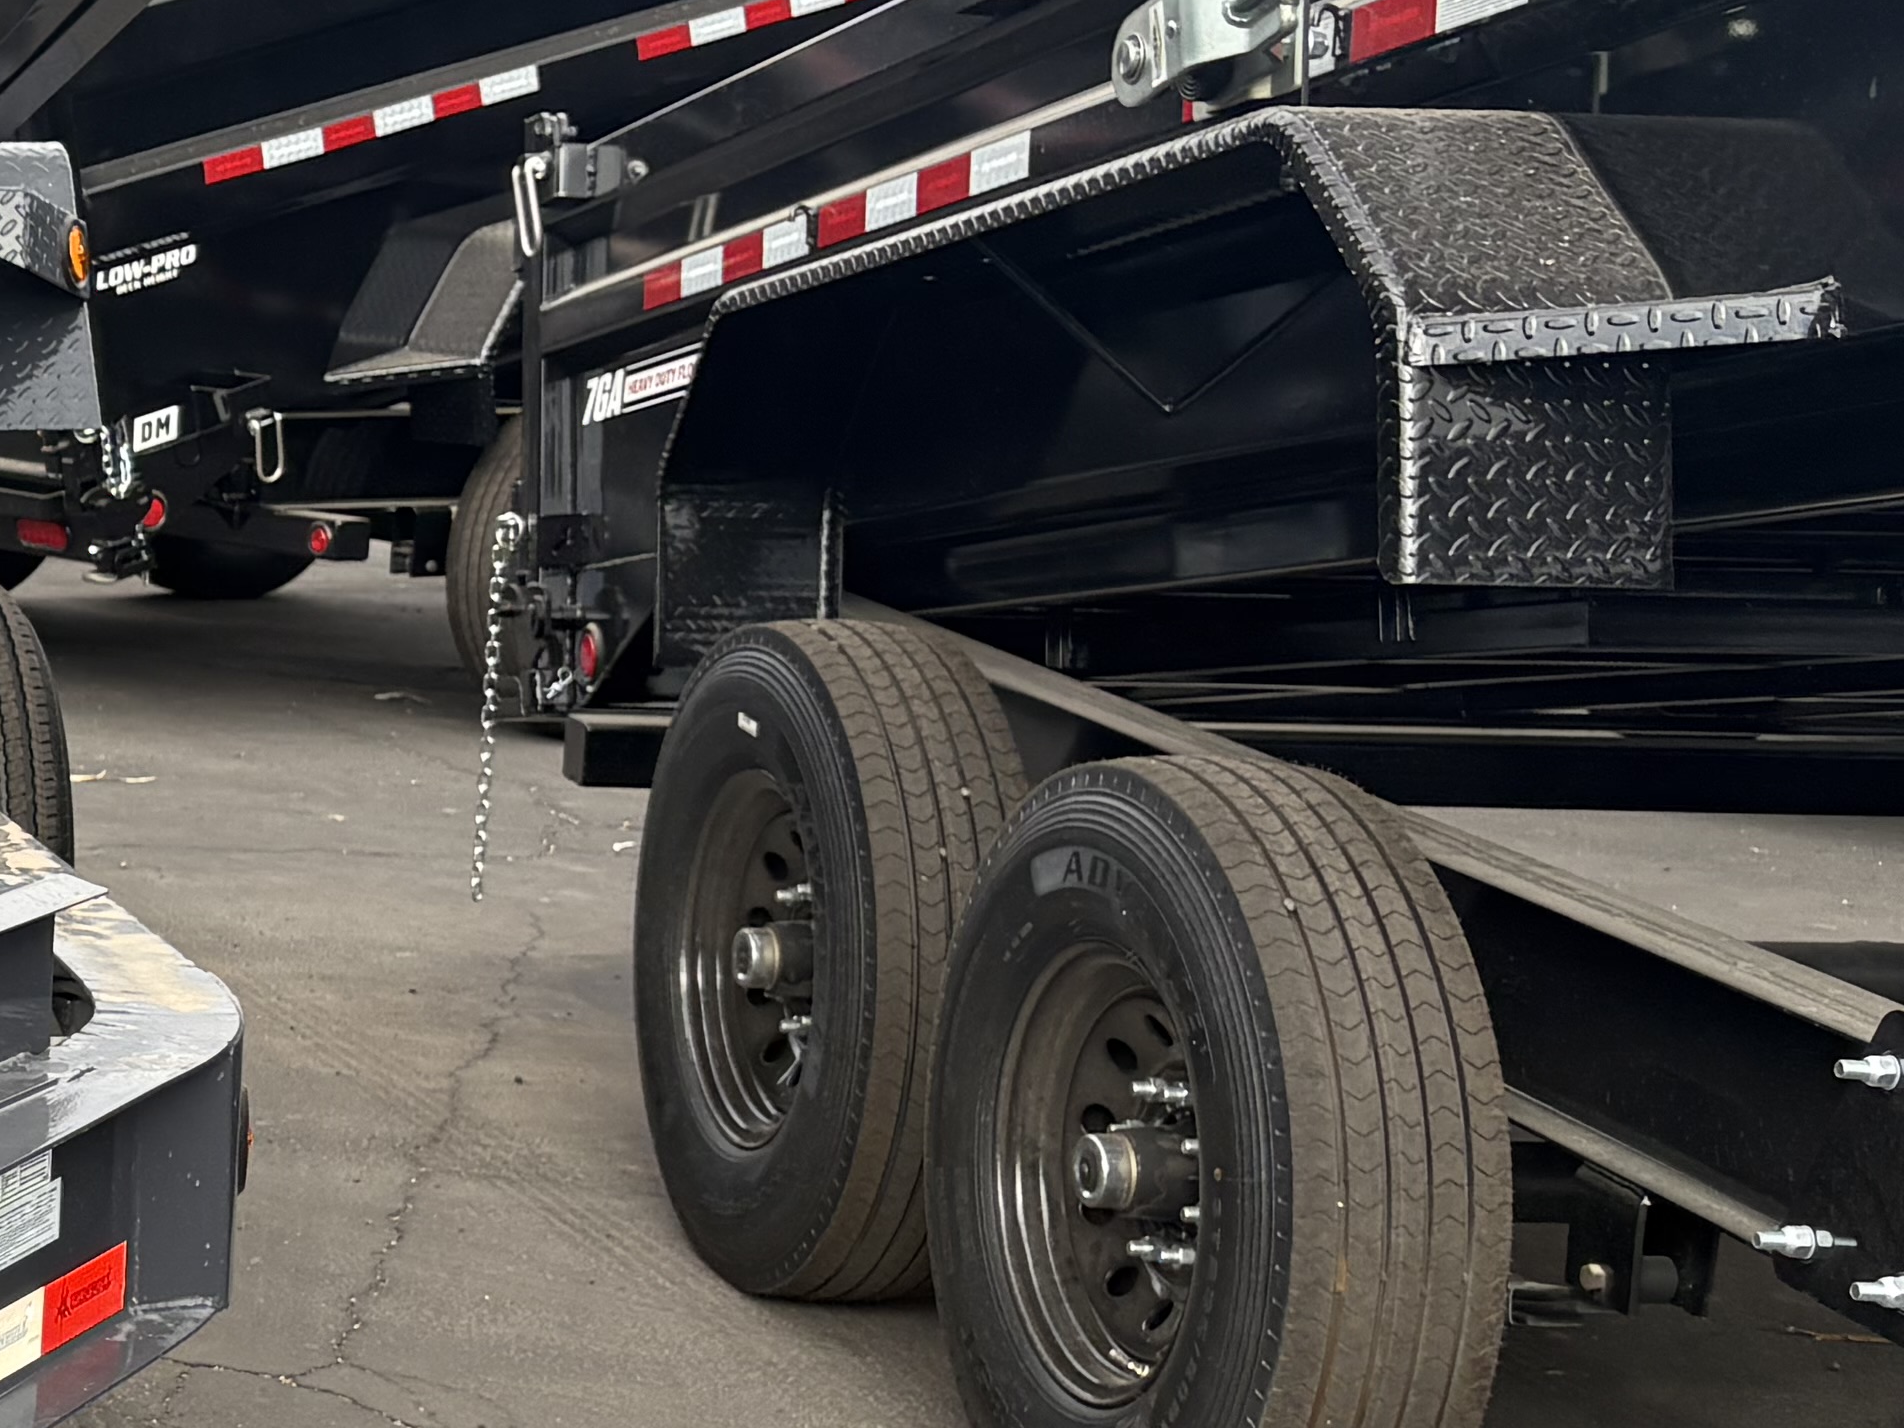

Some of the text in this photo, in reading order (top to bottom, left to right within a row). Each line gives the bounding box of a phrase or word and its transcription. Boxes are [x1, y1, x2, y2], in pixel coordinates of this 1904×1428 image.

[95, 244, 196, 291] LOW-PRO
[582, 368, 625, 426] 7GA
[677, 361, 695, 380] FLO
[141, 413, 171, 443] DM
